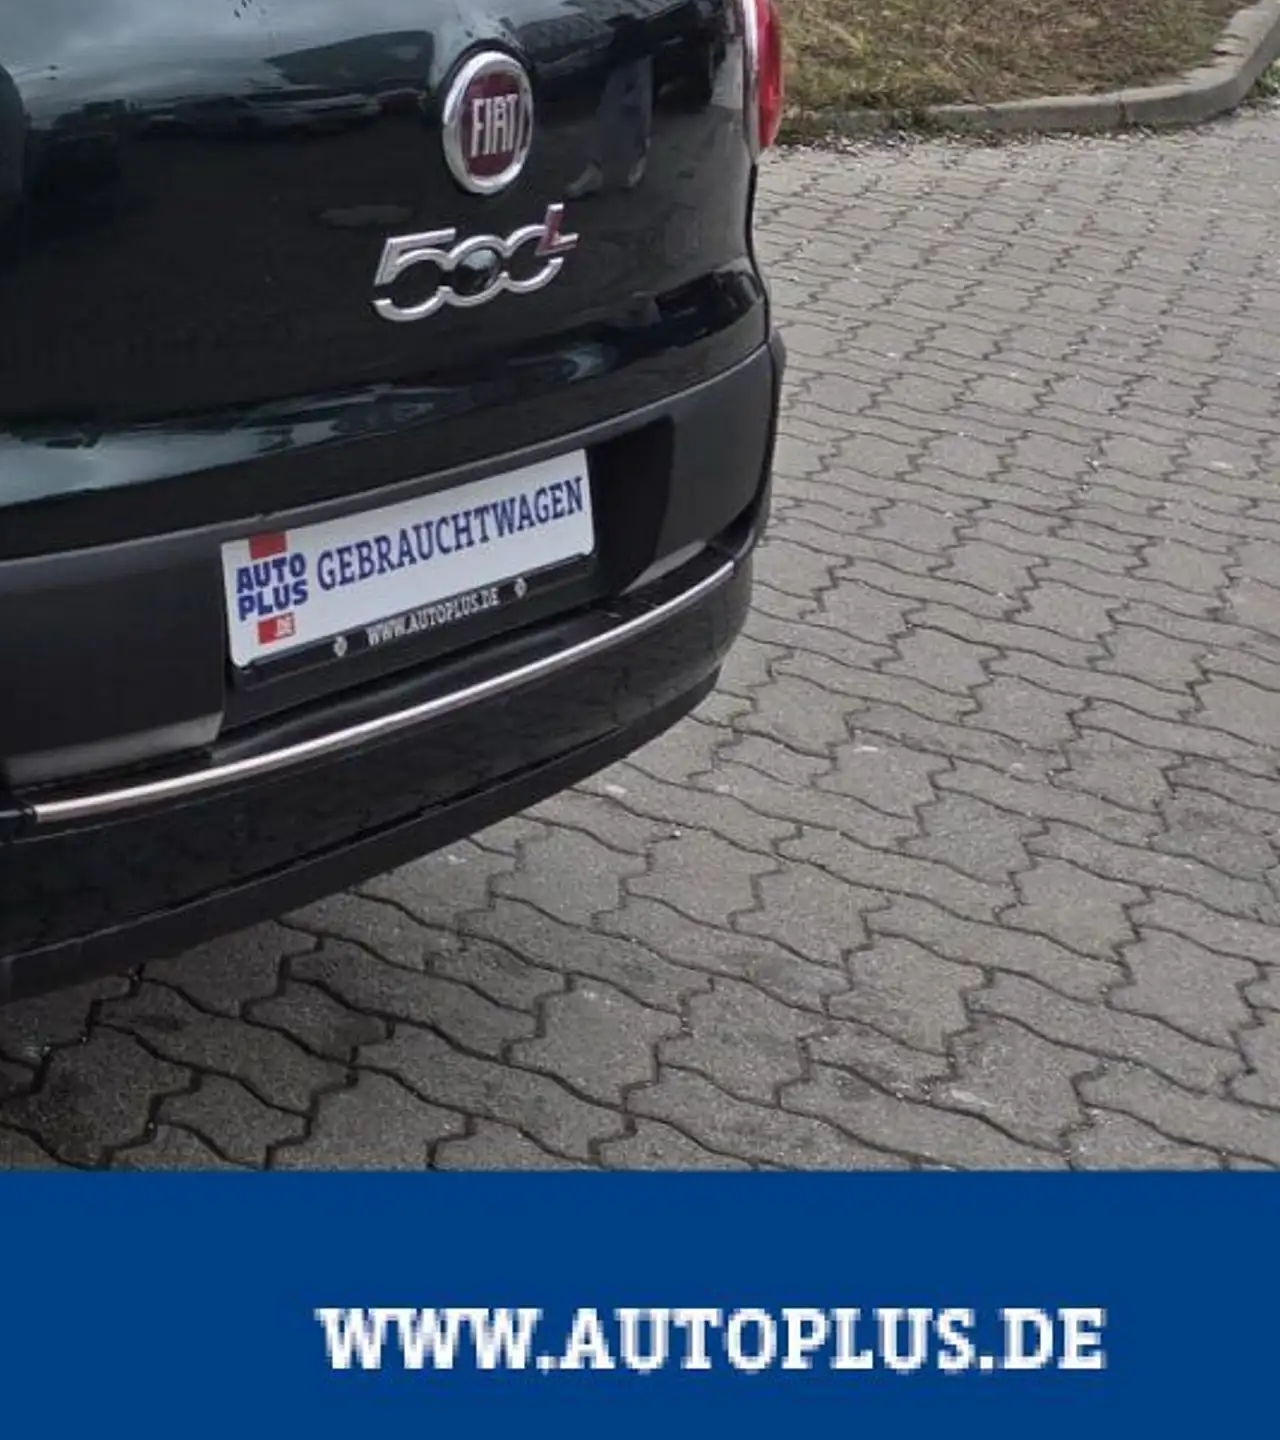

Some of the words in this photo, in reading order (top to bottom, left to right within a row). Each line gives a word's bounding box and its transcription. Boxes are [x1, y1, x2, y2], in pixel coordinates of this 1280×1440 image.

[471, 94, 519, 157] FIAT
[316, 476, 584, 591] GEBRAUCHTWAGEN
[236, 552, 307, 594] AUTO
[238, 578, 309, 621] PLUS
[365, 587, 500, 647] WWW.AUTOPLUS.DE
